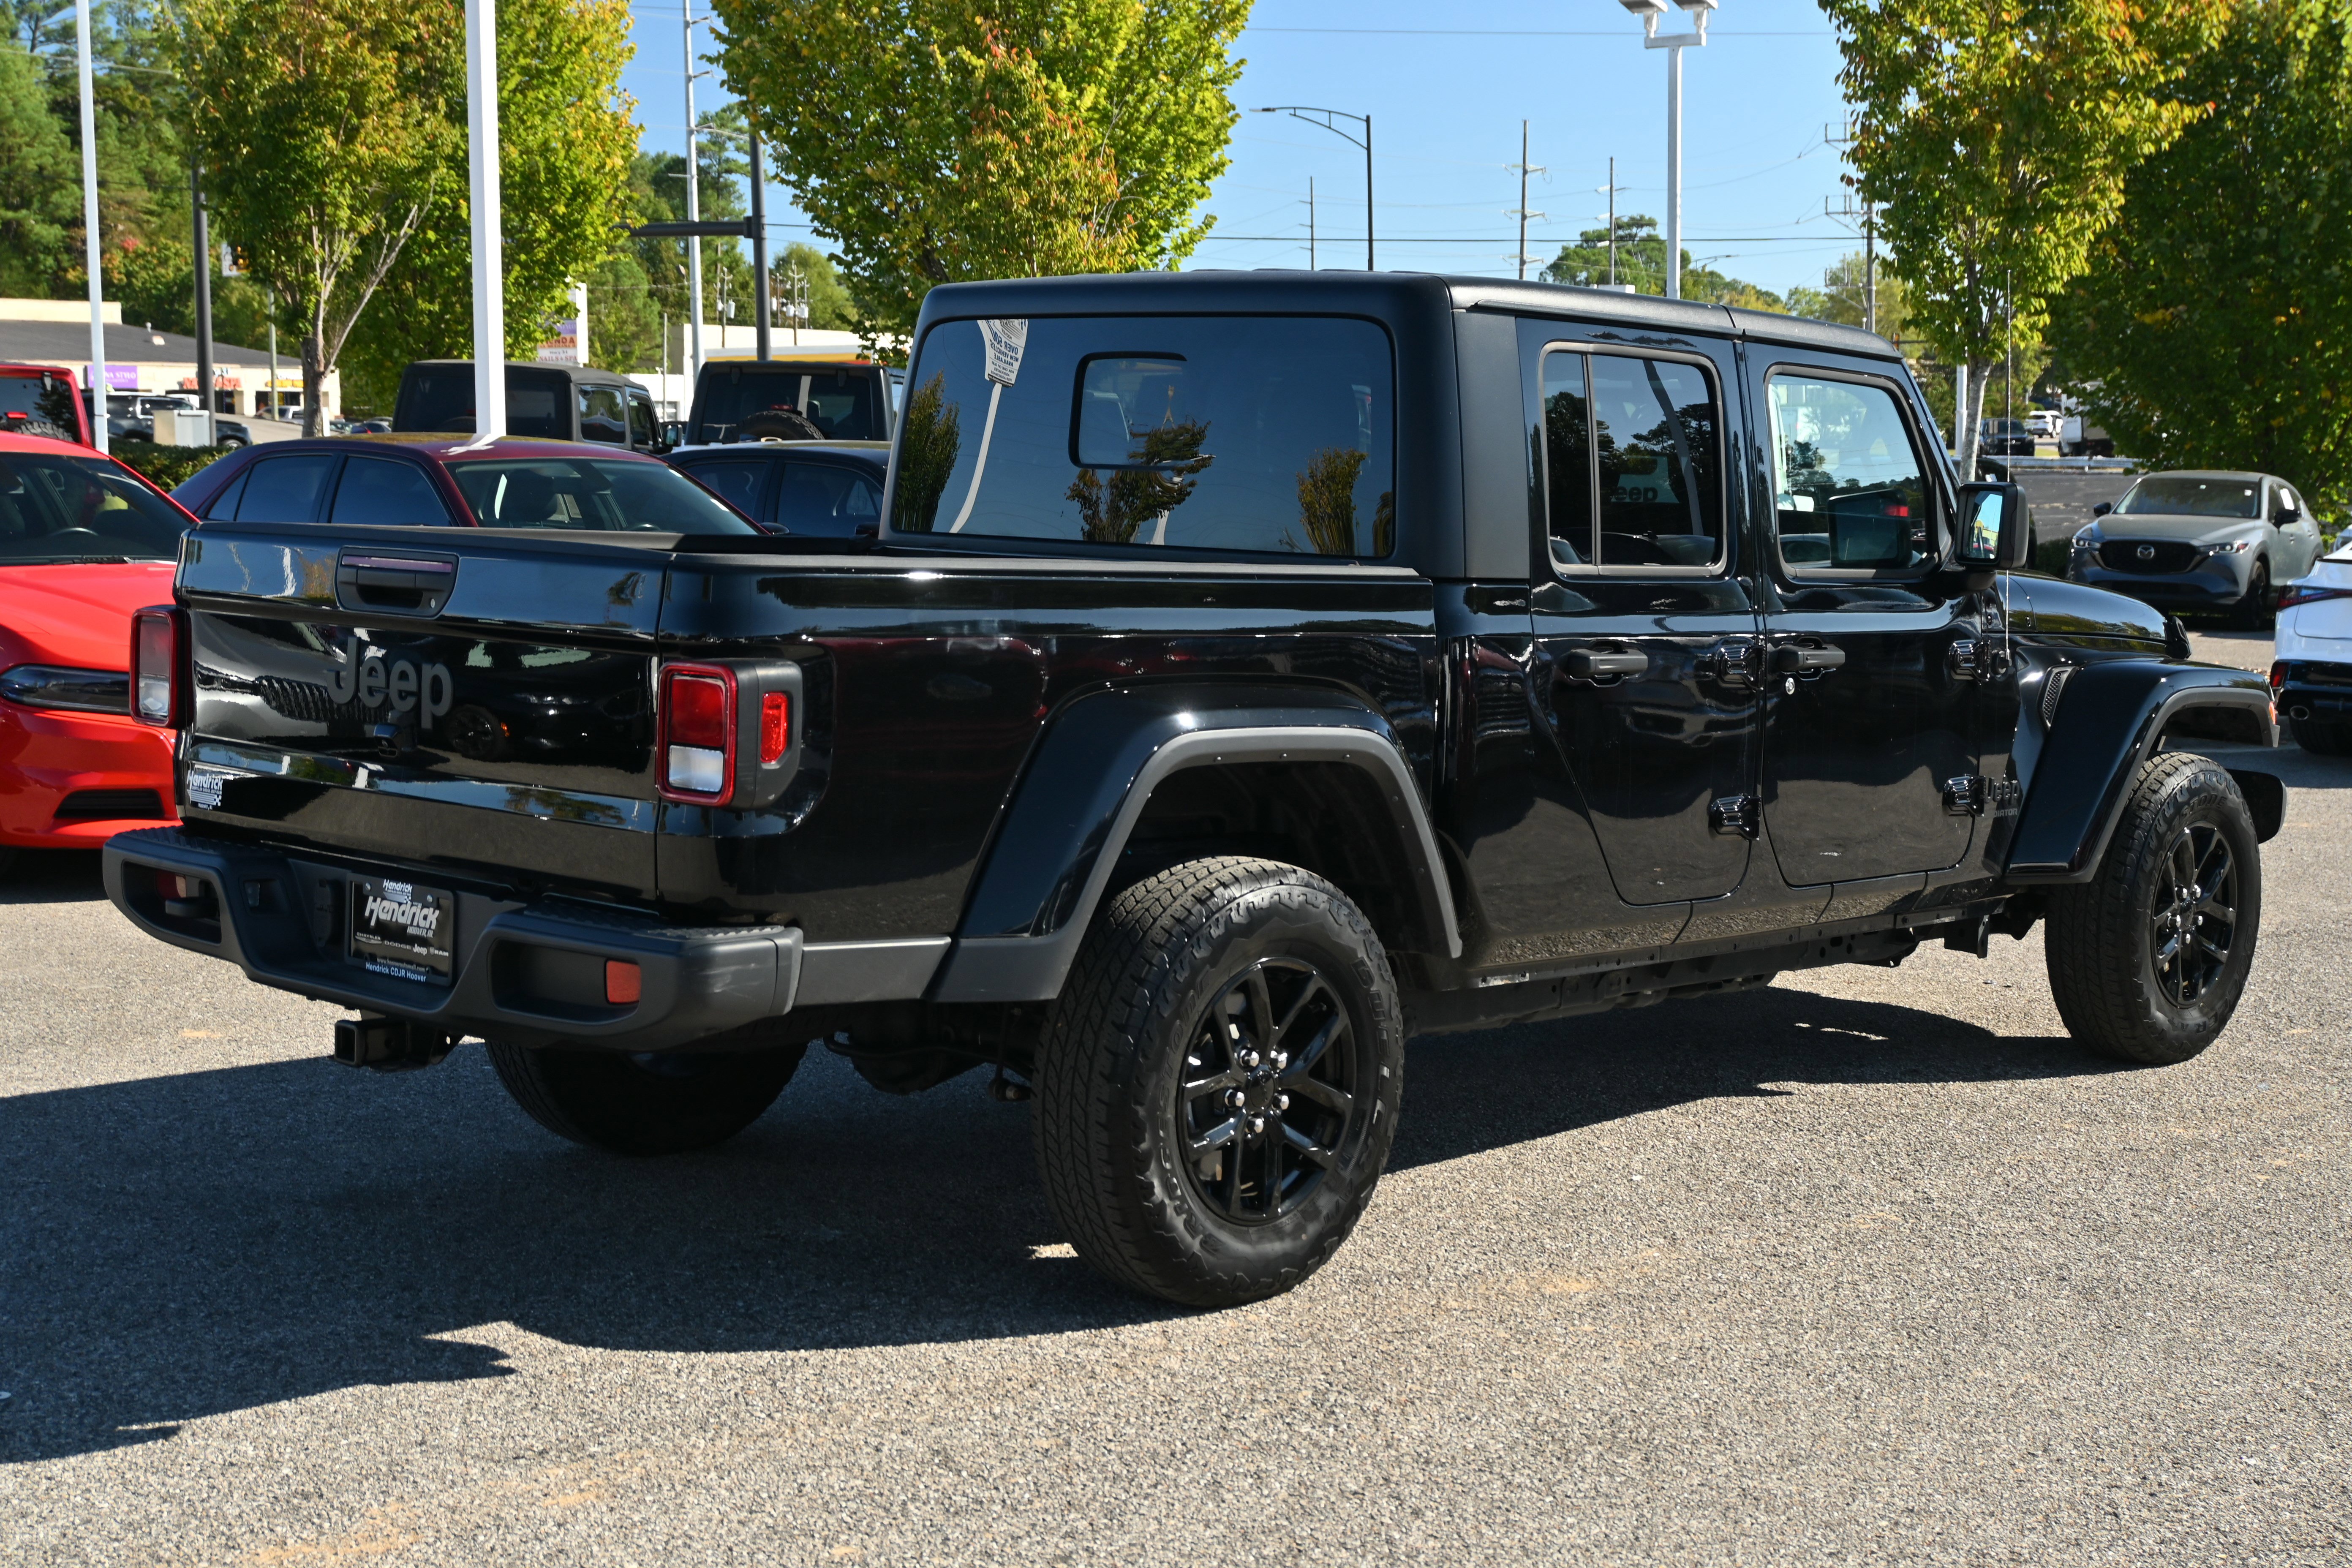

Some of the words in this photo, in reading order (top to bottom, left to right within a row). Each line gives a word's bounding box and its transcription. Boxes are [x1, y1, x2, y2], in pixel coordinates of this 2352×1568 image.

[223, 377, 242, 389] SPA
[1614, 487, 1658, 503] eep
[326, 635, 454, 730] Jeep
[186, 770, 223, 790] Hendrick
[1985, 777, 2020, 804] Jeep
[383, 879, 413, 893] Hendrick
[365, 896, 440, 930] Hendrick
[357, 932, 381, 940] CHRYSLER
[384, 940, 412, 950] DODGE
[413, 943, 427, 956] Jeep
[366, 961, 389, 974] Hendrick
[390, 967, 406, 977] CDJR
[407, 971, 426, 982] Hoover
